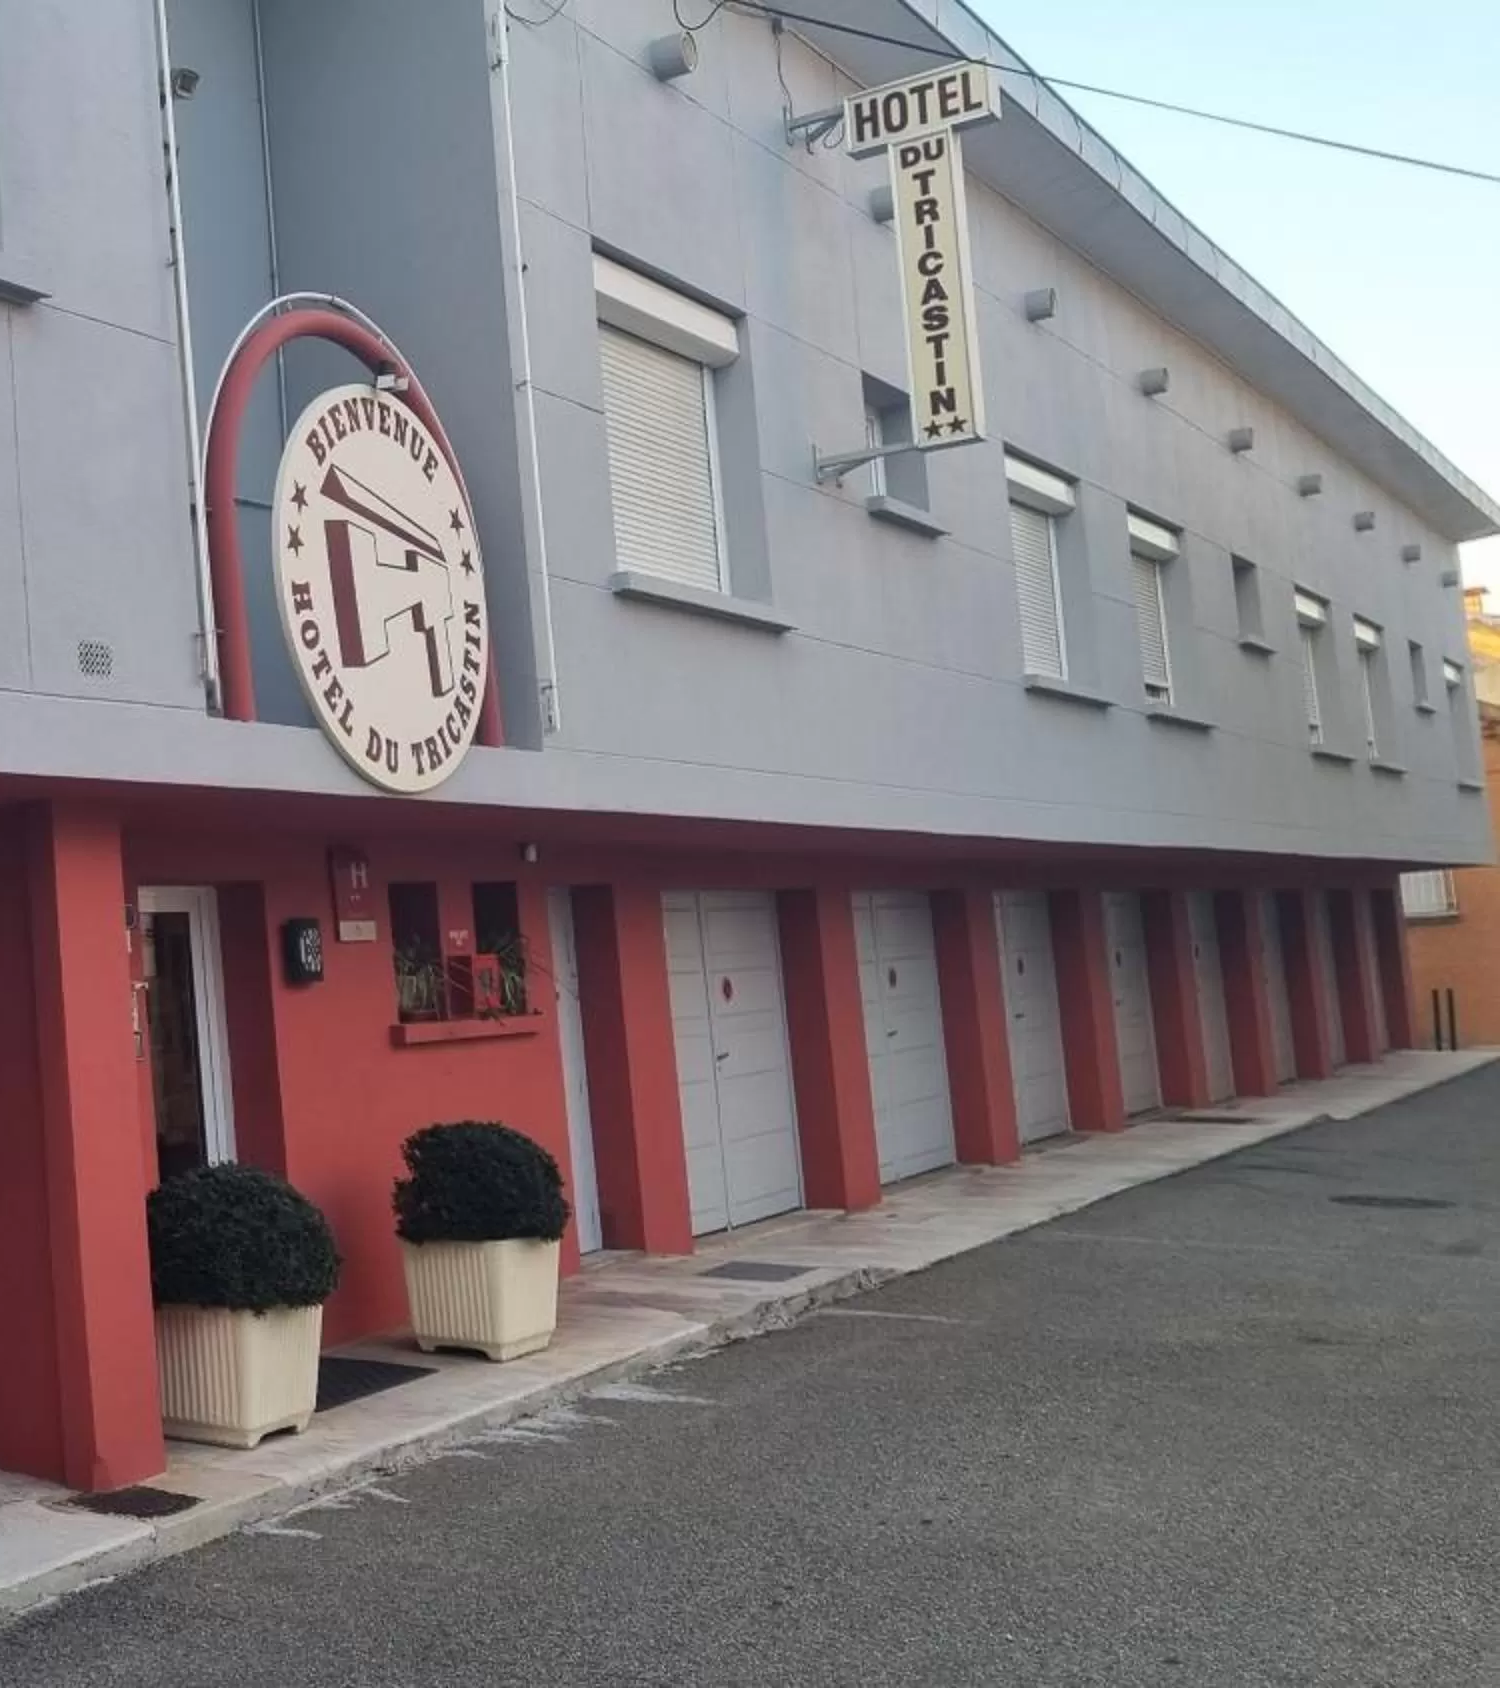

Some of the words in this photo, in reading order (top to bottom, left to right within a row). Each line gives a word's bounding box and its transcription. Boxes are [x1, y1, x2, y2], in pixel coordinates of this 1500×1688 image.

[853, 71, 983, 142] HOTEL
[900, 138, 944, 169] DU
[912, 170, 956, 415] TRICASTIN
[306, 397, 439, 483] BIENVENUE
[290, 581, 353, 736] HOTEL
[366, 726, 399, 774] DU
[411, 601, 480, 775] TRICASTIN
[351, 862, 368, 889] H
